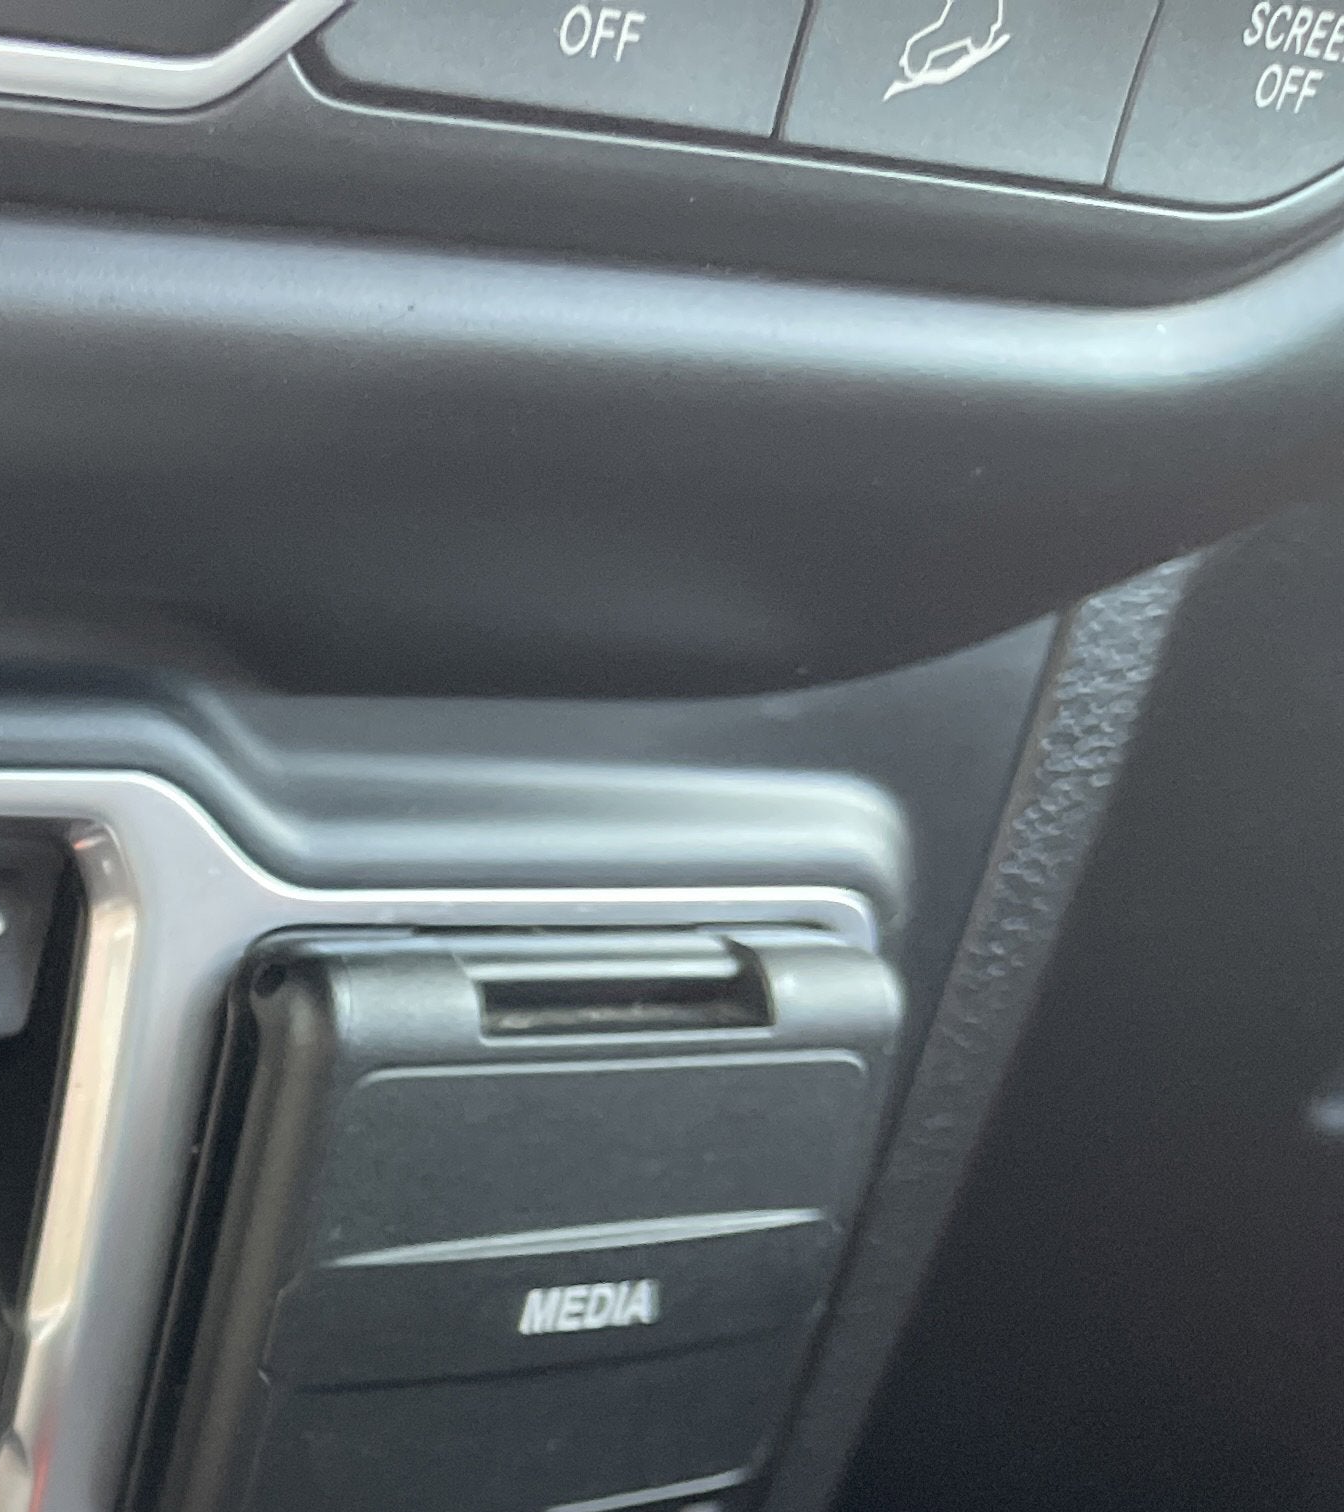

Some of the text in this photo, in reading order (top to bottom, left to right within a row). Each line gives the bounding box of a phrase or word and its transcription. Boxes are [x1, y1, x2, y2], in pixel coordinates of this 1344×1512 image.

[558, 4, 645, 63] OFF
[1243, 0, 1344, 62] SCREE
[1255, 63, 1324, 114] OFF
[518, 1278, 658, 1336] MEDIA
